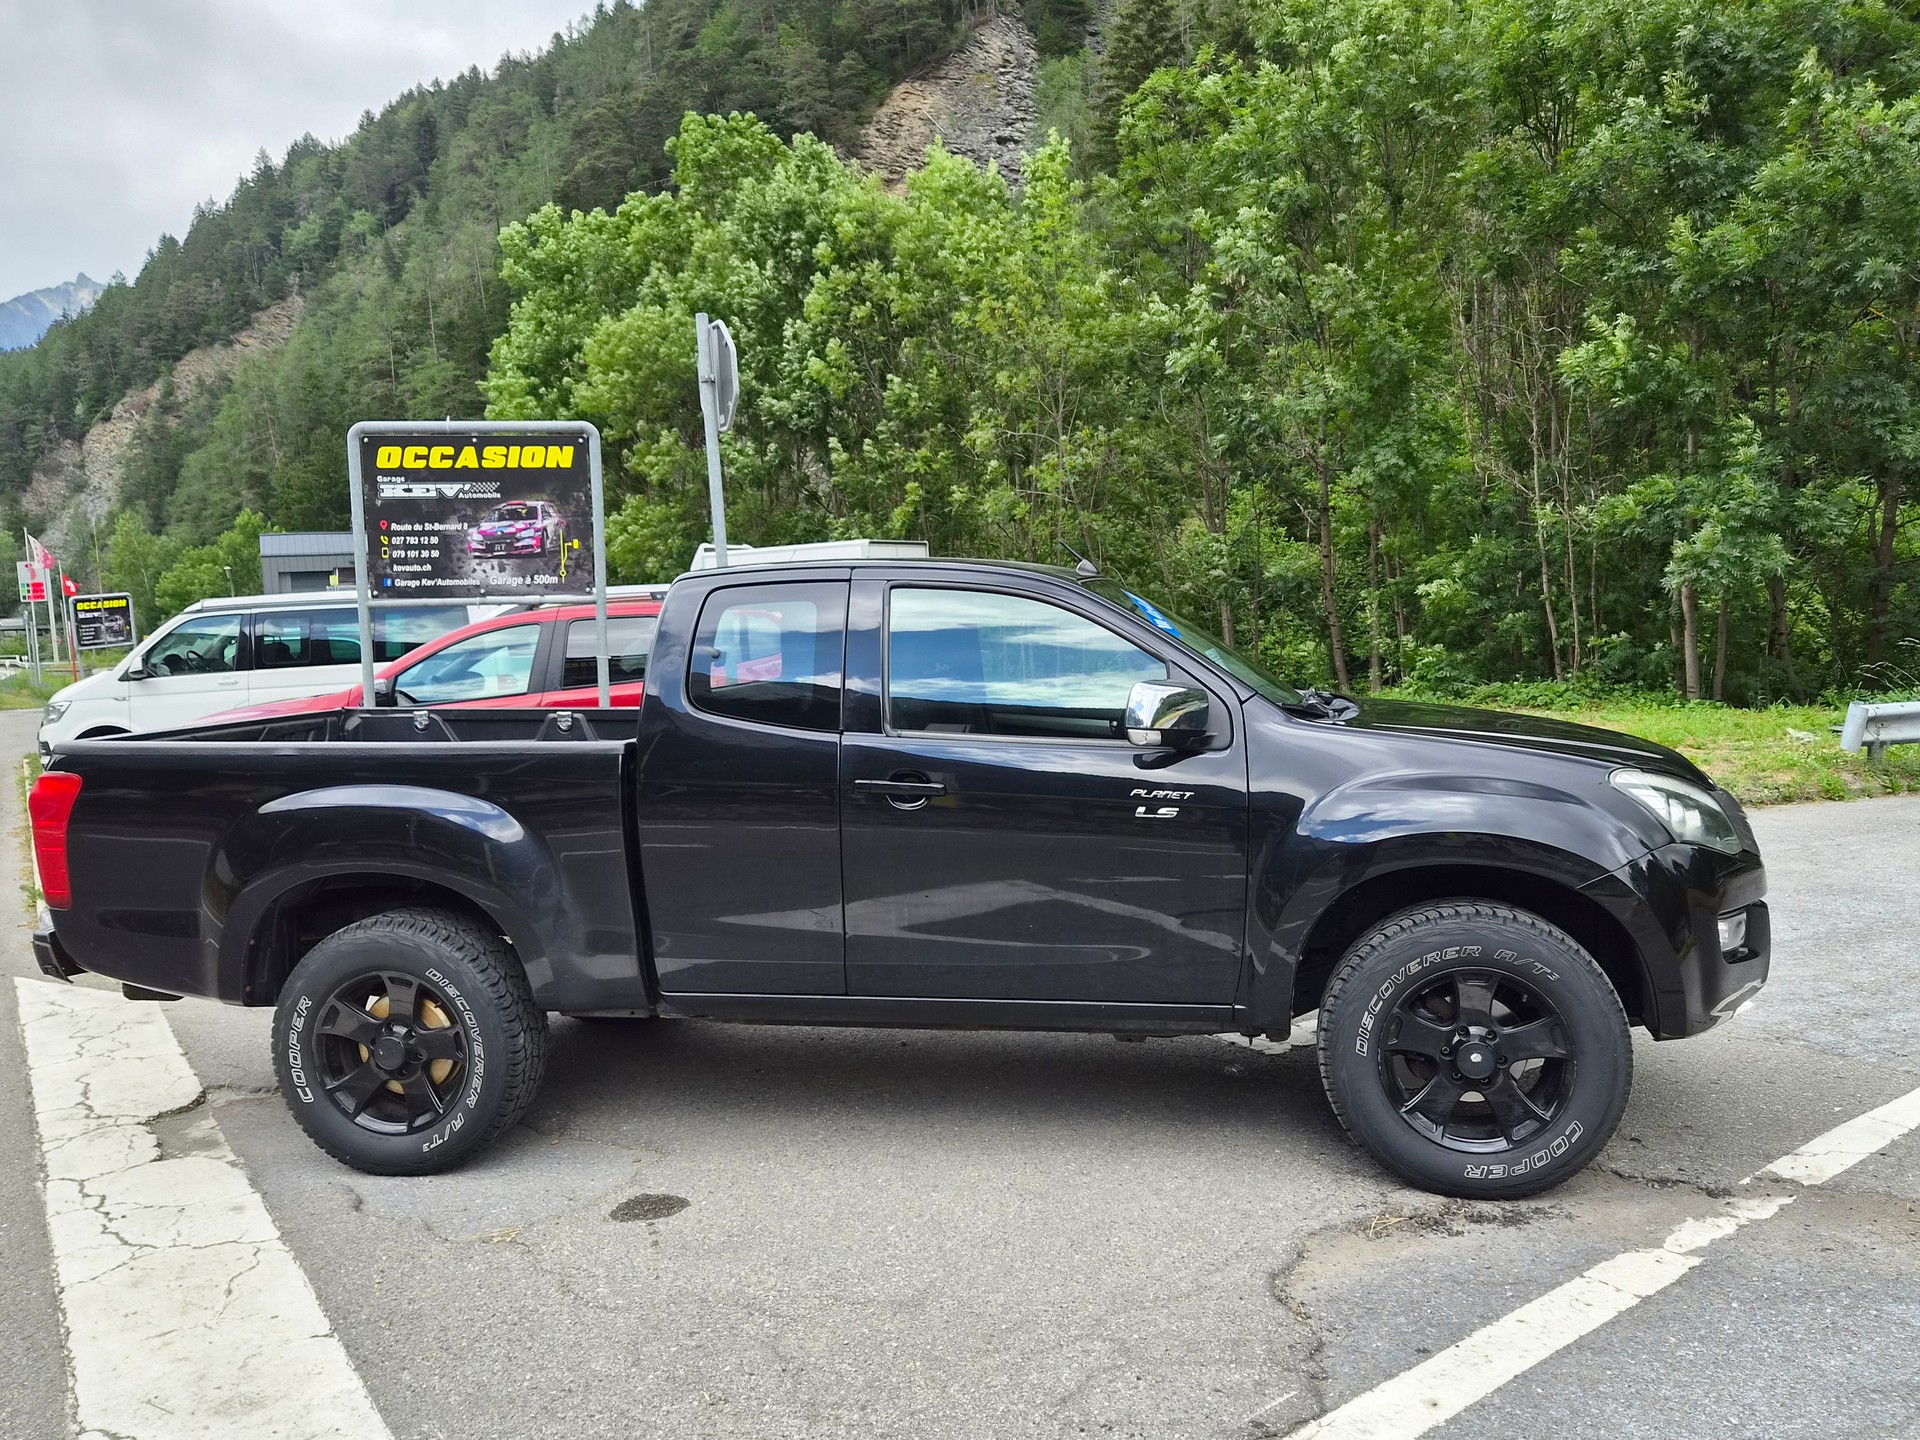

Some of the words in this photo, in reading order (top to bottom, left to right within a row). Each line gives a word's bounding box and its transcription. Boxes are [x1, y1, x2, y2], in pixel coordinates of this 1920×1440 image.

[376, 446, 574, 468] OCCASION
[391, 522, 412, 531] Route
[413, 522, 423, 531] du
[424, 522, 462, 531] St-Bernard
[391, 536, 405, 545] 027
[406, 536, 419, 545] 783
[420, 536, 428, 545] 12
[429, 536, 439, 545] 50
[494, 543, 506, 551] RT
[392, 550, 406, 559] 079
[407, 550, 419, 558] 101
[420, 550, 430, 558] 30
[431, 550, 440, 558] 50
[393, 563, 432, 572] kevauto.ch
[394, 579, 420, 588] Garage
[421, 578, 481, 587] Kev'Automobiles
[490, 575, 523, 587] Garage
[525, 574, 532, 585] à
[533, 574, 558, 585] 500m
[77, 599, 127, 610] OCCASION
[1130, 789, 1194, 799] PLANET
[1135, 806, 1179, 818] LS
[1355, 945, 1482, 1057] DISCOVERER
[425, 967, 486, 1109] DISCOVERER
[288, 995, 314, 1103] COOPER
[1463, 1119, 1584, 1179] COOPER
